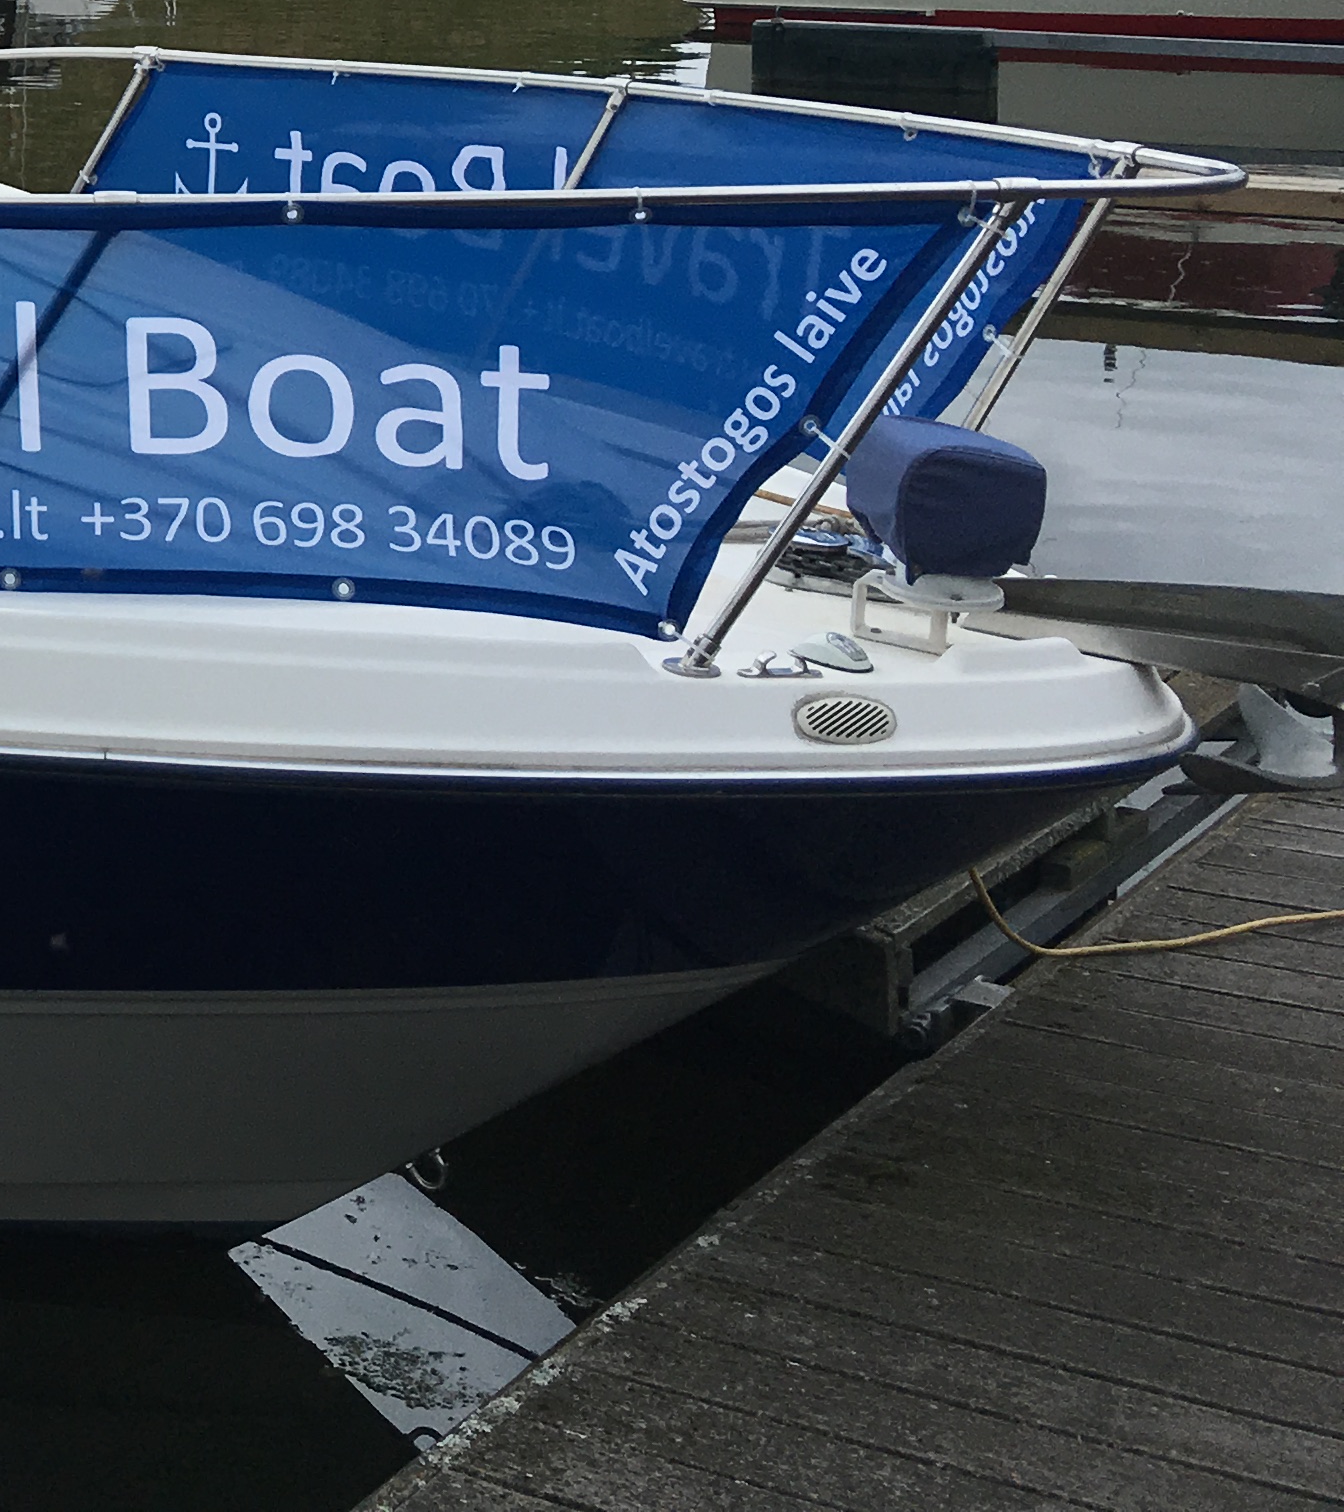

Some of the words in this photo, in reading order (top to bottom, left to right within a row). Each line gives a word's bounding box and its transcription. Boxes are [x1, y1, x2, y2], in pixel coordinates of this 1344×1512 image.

[124, 315, 551, 481] Boat
[614, 364, 797, 596] Atostogos
[773, 247, 888, 364] laive
[80, 496, 232, 543] +370
[252, 500, 366, 549] 698
[387, 505, 577, 571] 34089
